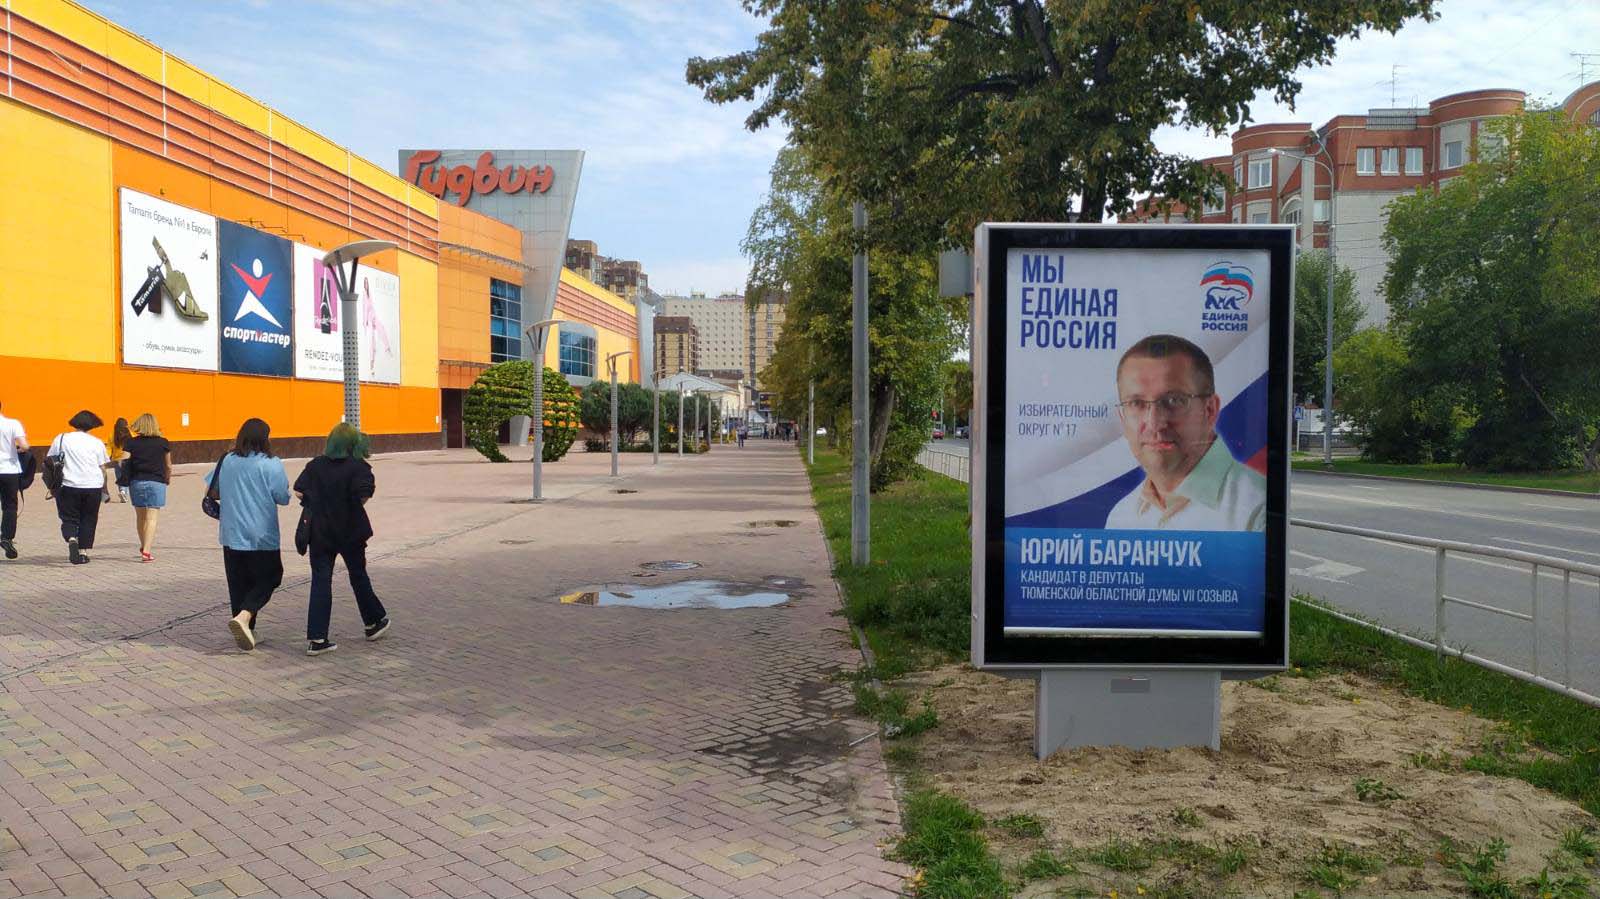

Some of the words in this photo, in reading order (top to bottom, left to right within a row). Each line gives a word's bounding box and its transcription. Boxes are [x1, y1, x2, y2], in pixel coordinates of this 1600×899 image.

[404, 150, 554, 207] Гудвин
[153, 210, 173, 226] бренд
[1021, 254, 1064, 284] МЫ
[1021, 287, 1118, 319] ЕДИНАЯ
[1202, 312, 1248, 322] ЕДИНАЯ
[1020, 319, 1117, 350] РОССИЯ
[1201, 322, 1248, 332] РОССИЯ
[304, 349, 343, 362] RENDEZ-VOU
[1018, 403, 1108, 418] ИЗБИРАТЕЛЬНЫЙ
[1018, 422, 1050, 436] ОКРУГ
[1065, 423, 1076, 436] 17
[1021, 534, 1084, 565] ЮРИЙ
[1089, 539, 1202, 567] БАРАНЧУК
[1020, 570, 1078, 585] КАНДИДАТ
[1079, 571, 1087, 583] В
[1088, 571, 1145, 586] ДЕПУТАТЫ
[1021, 585, 1084, 600] ТЮМЕНСКОЙ
[1086, 585, 1146, 602] ОБЛАСТНОЙ
[1147, 589, 1180, 603] ДУМЫ
[1182, 589, 1195, 602] VII
[1197, 589, 1239, 603] СОЗЫВА
